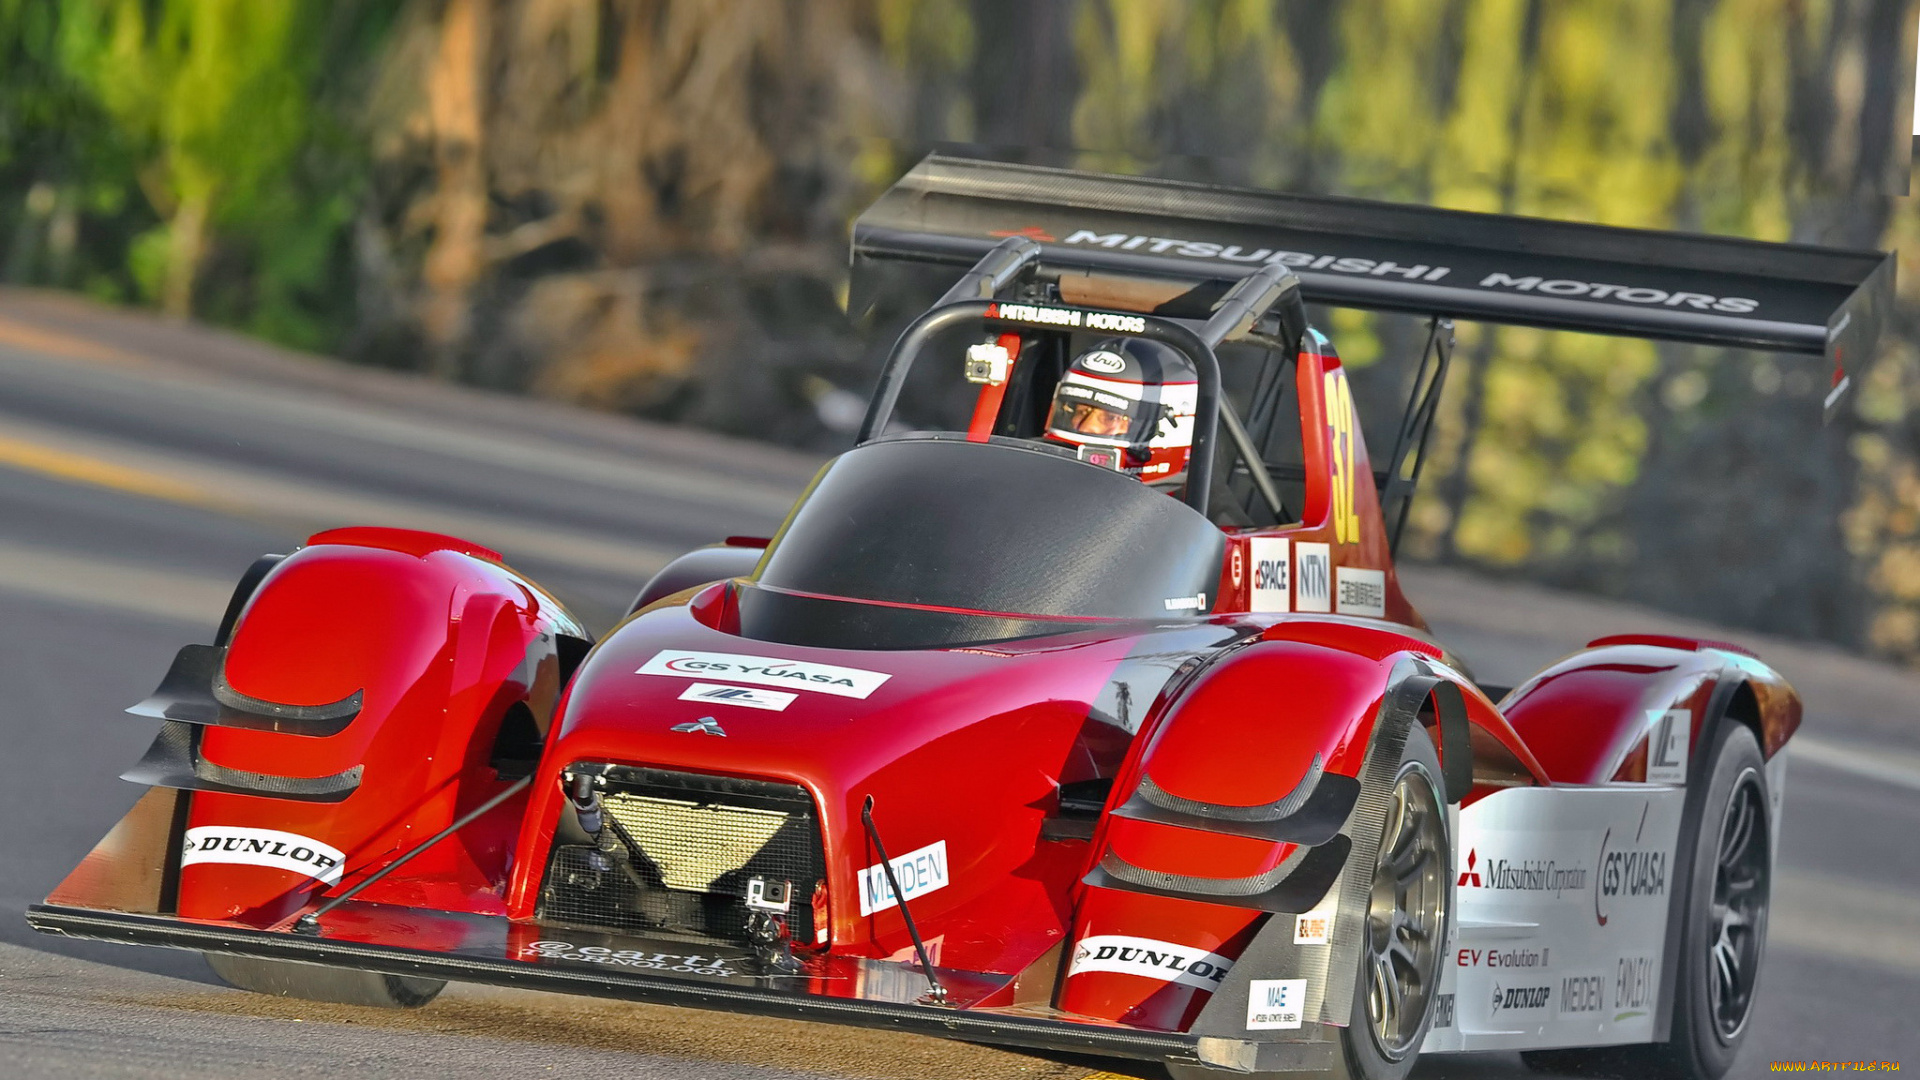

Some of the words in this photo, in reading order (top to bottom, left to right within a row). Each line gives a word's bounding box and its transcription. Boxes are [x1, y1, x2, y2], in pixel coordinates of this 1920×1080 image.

[1064, 229, 1451, 282] MITSUBISHI
[1479, 272, 1760, 313] MOTORS
[1000, 303, 1081, 327] MITSUBISHI
[1086, 312, 1145, 334] MOTORS
[1324, 372, 1360, 545] 32
[1254, 559, 1287, 591] dSPACE
[1300, 554, 1328, 599] NTN
[684, 660, 731, 672] GS
[738, 664, 854, 688] YUASA
[198, 836, 337, 868] DUNLOP
[1484, 858, 1545, 890] Mitsubishi
[1602, 851, 1622, 896] GS
[1623, 851, 1666, 896] YUASA
[521, 948, 738, 978] TECHNOLOGY
[1457, 949, 1482, 967] EV
[1487, 949, 1540, 967] Evolution
[1267, 986, 1288, 1007] MAE
[1503, 986, 1551, 1009] DUNLOP
[1560, 976, 1605, 1013] MEIDEN
